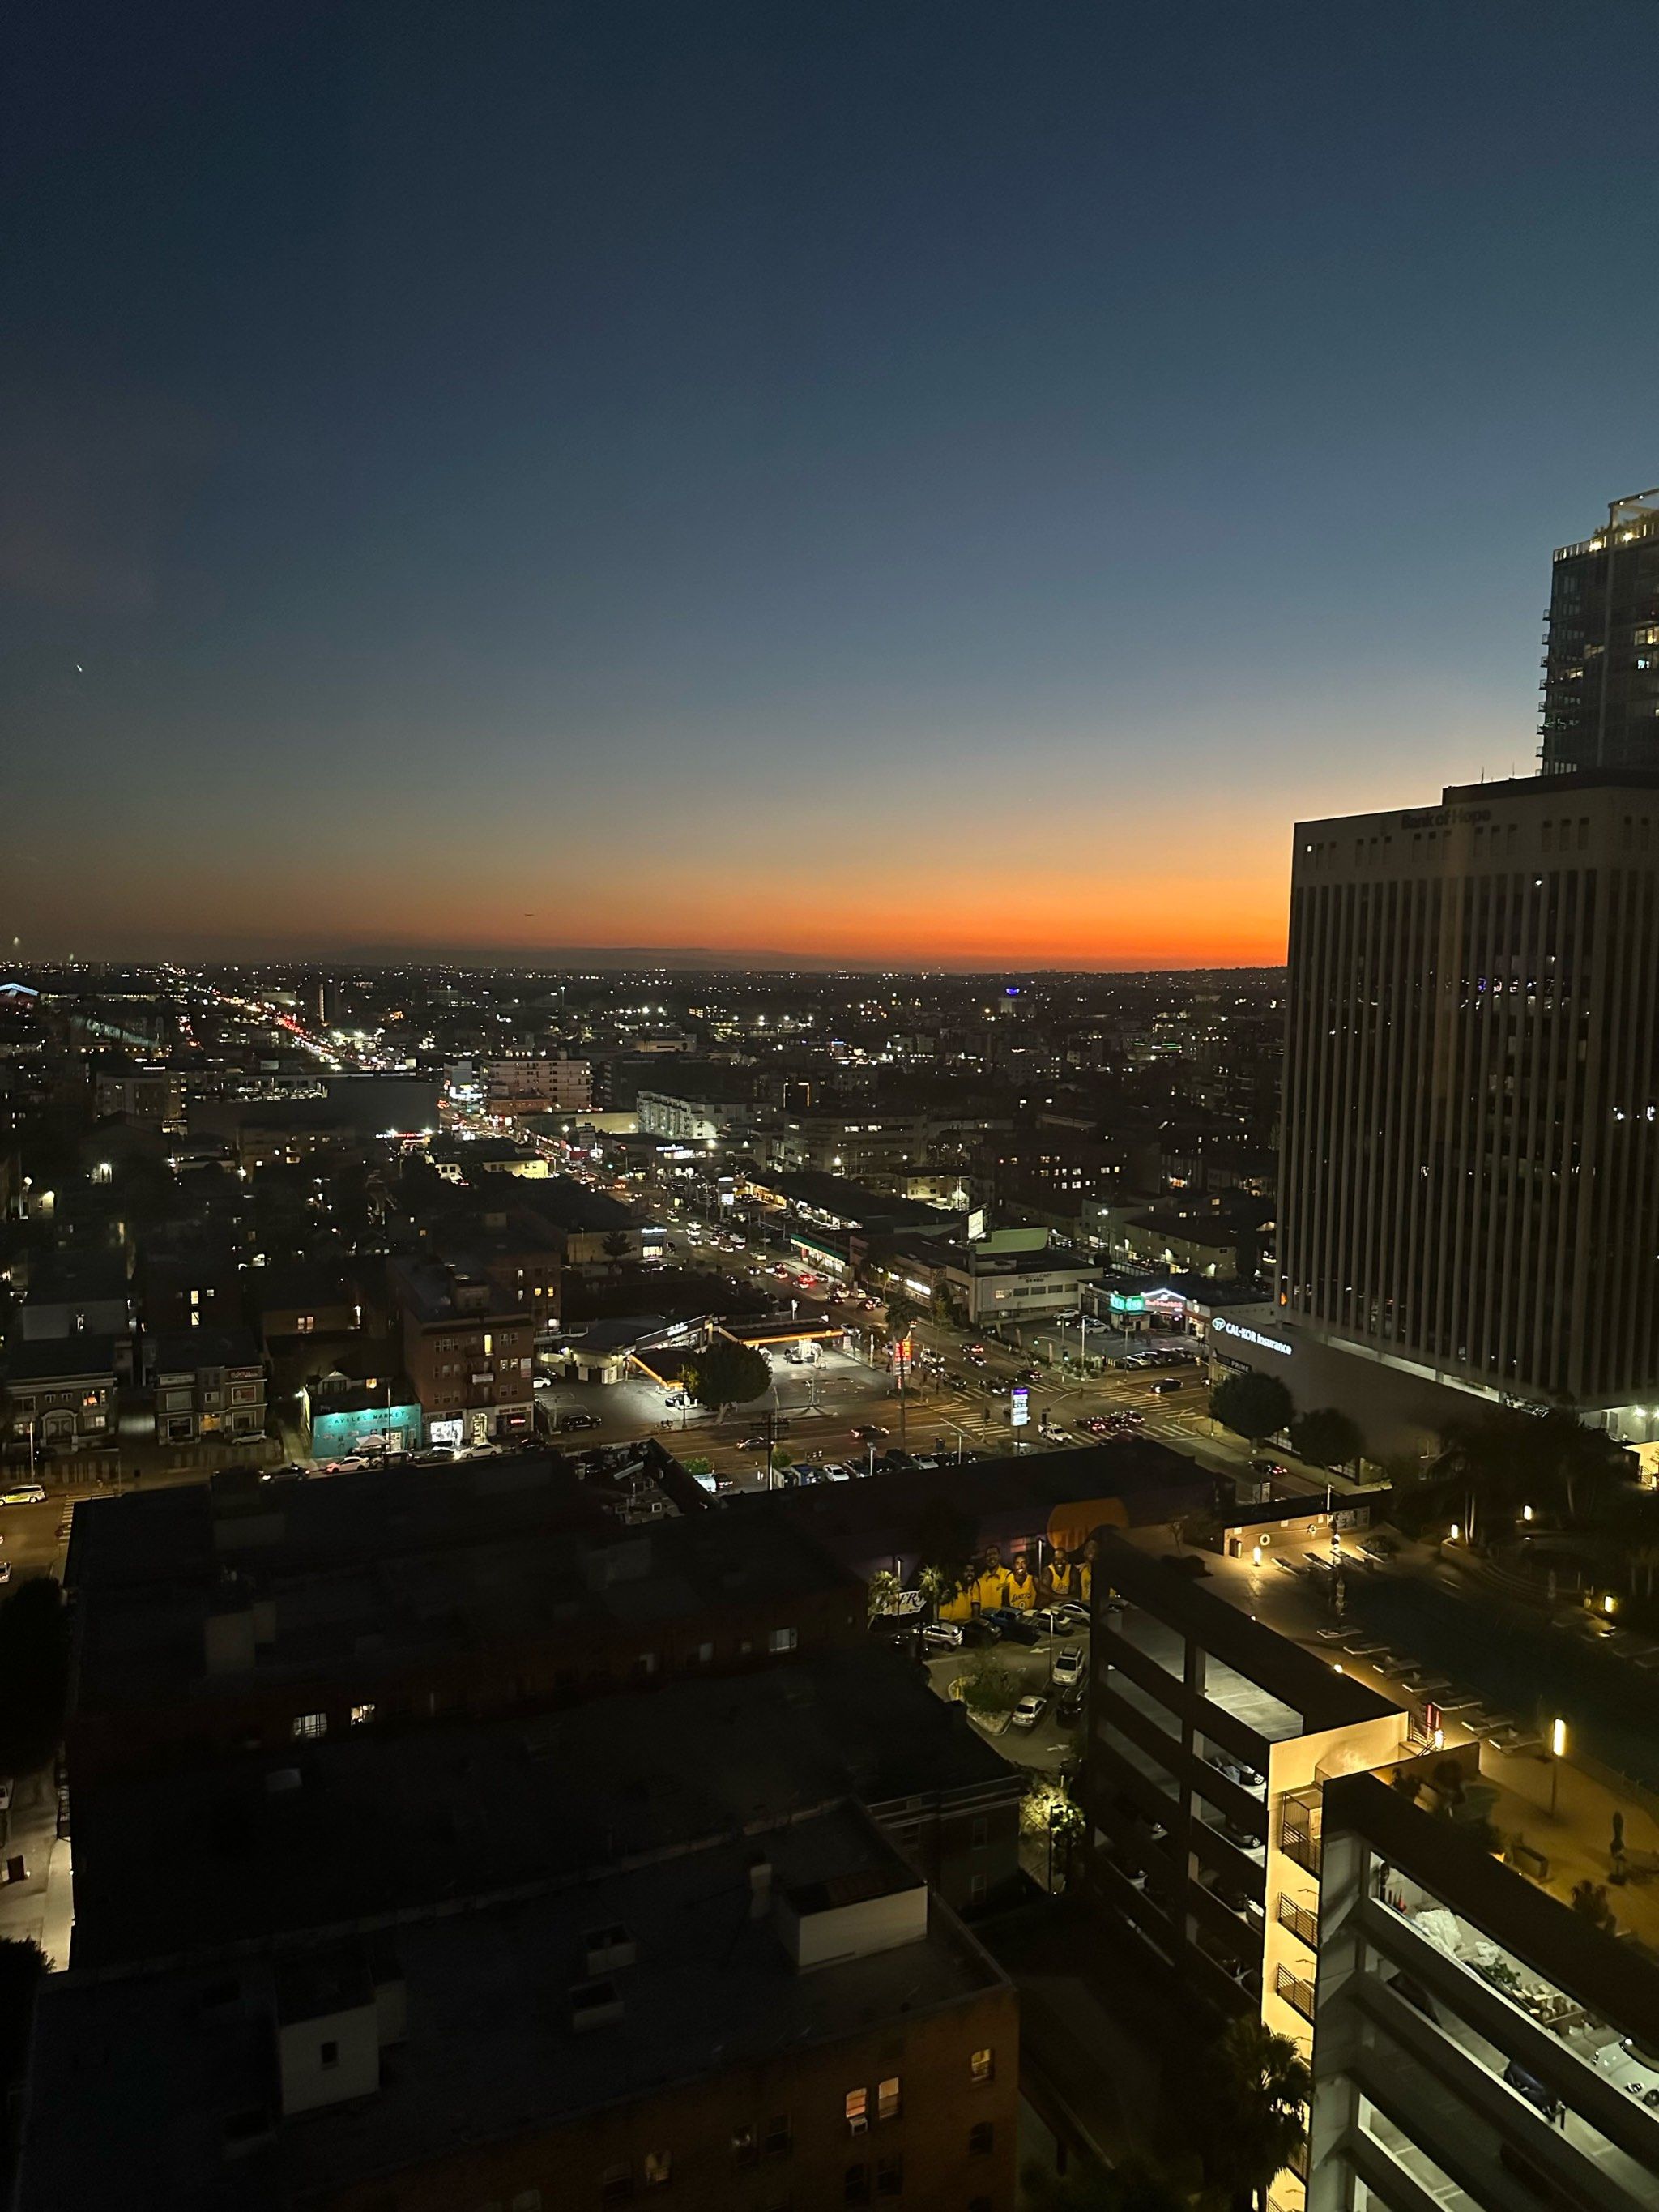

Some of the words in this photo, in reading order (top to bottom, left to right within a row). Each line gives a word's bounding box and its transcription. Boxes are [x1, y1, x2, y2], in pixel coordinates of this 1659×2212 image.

[1401, 812, 1434, 830] Bank
[1435, 809, 1450, 826] of
[1452, 808, 1491, 826] Hope
[1226, 1322, 1256, 1343] CAL-KOR
[335, 1416, 367, 1424] AVILES
[373, 1411, 406, 1420] MARKET
